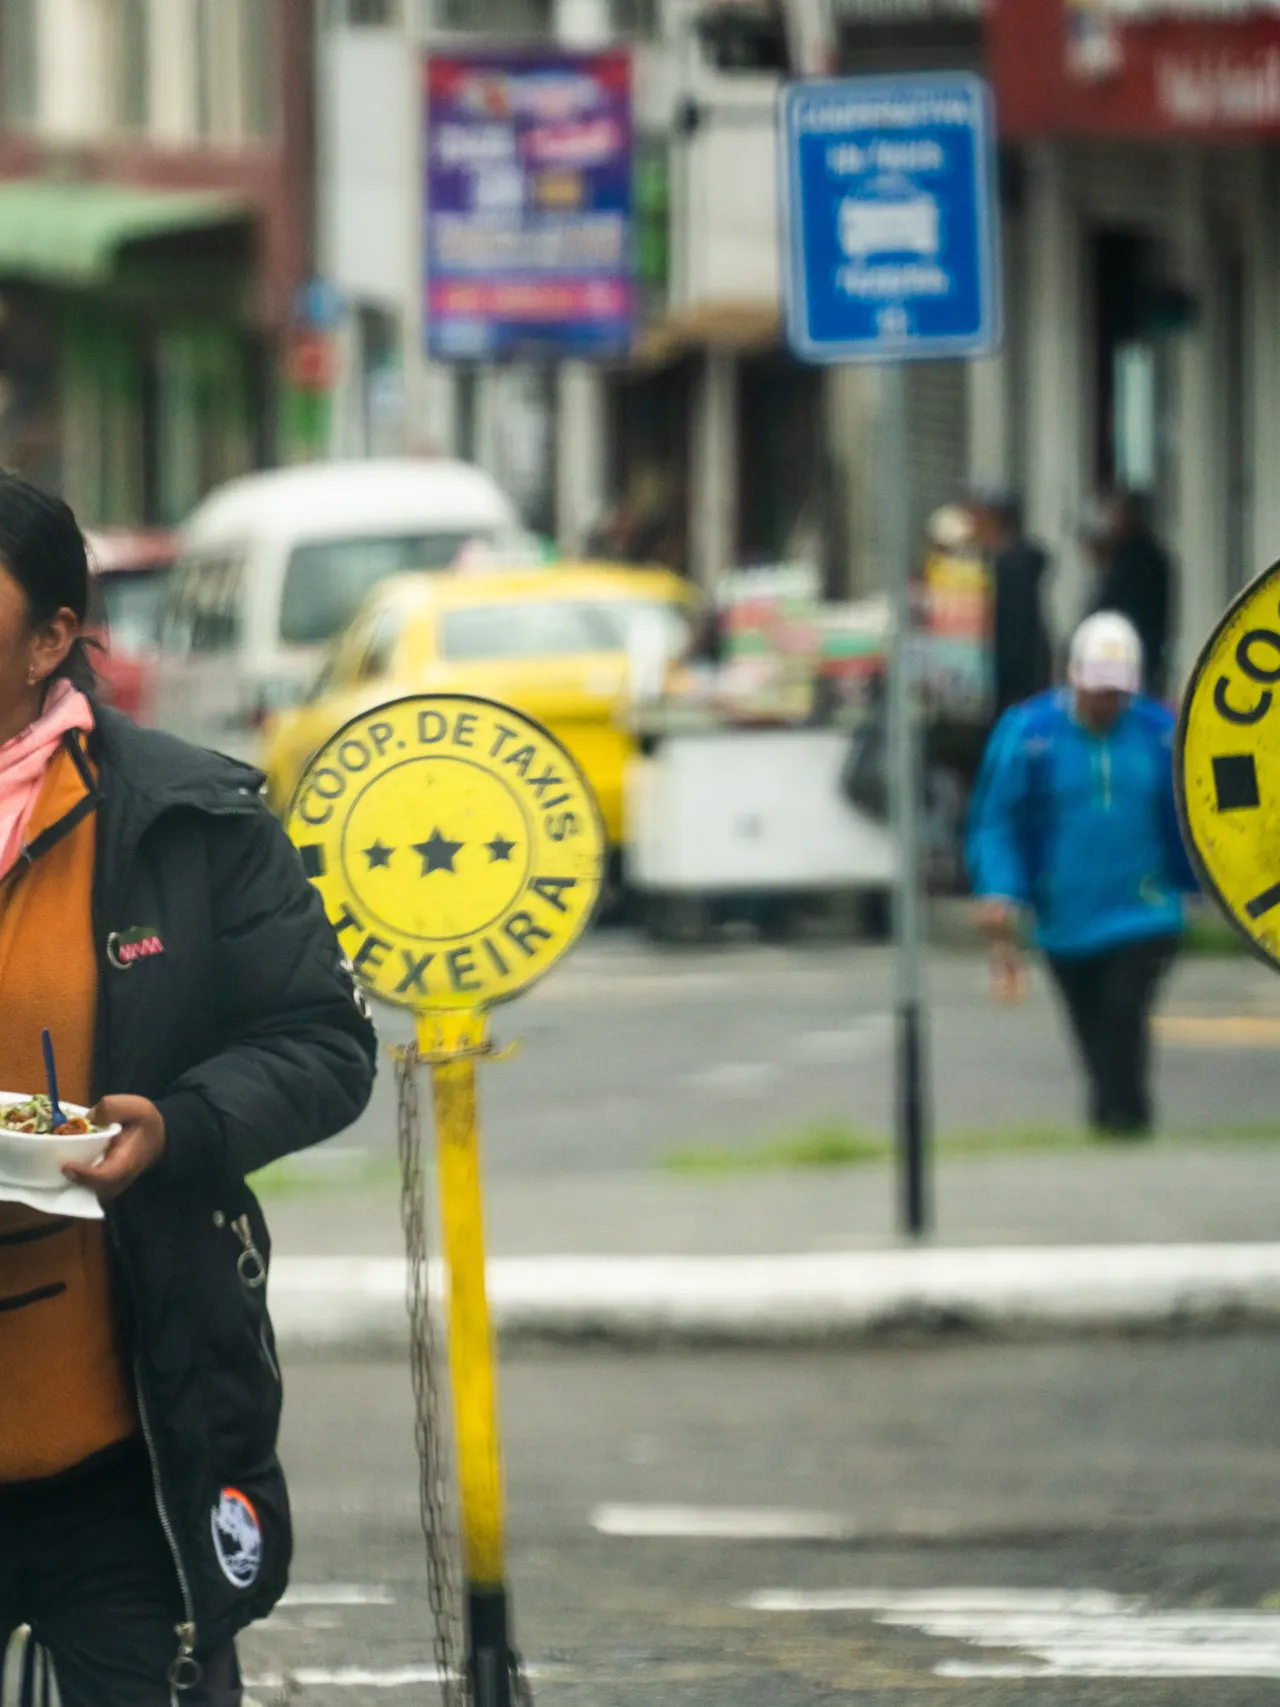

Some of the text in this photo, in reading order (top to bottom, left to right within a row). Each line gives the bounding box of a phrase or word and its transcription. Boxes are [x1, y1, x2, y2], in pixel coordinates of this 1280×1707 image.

[1214, 596, 1280, 726] CO
[299, 711, 579, 842] COOP. DE TAXIS
[332, 876, 578, 997] TEXEIRA
